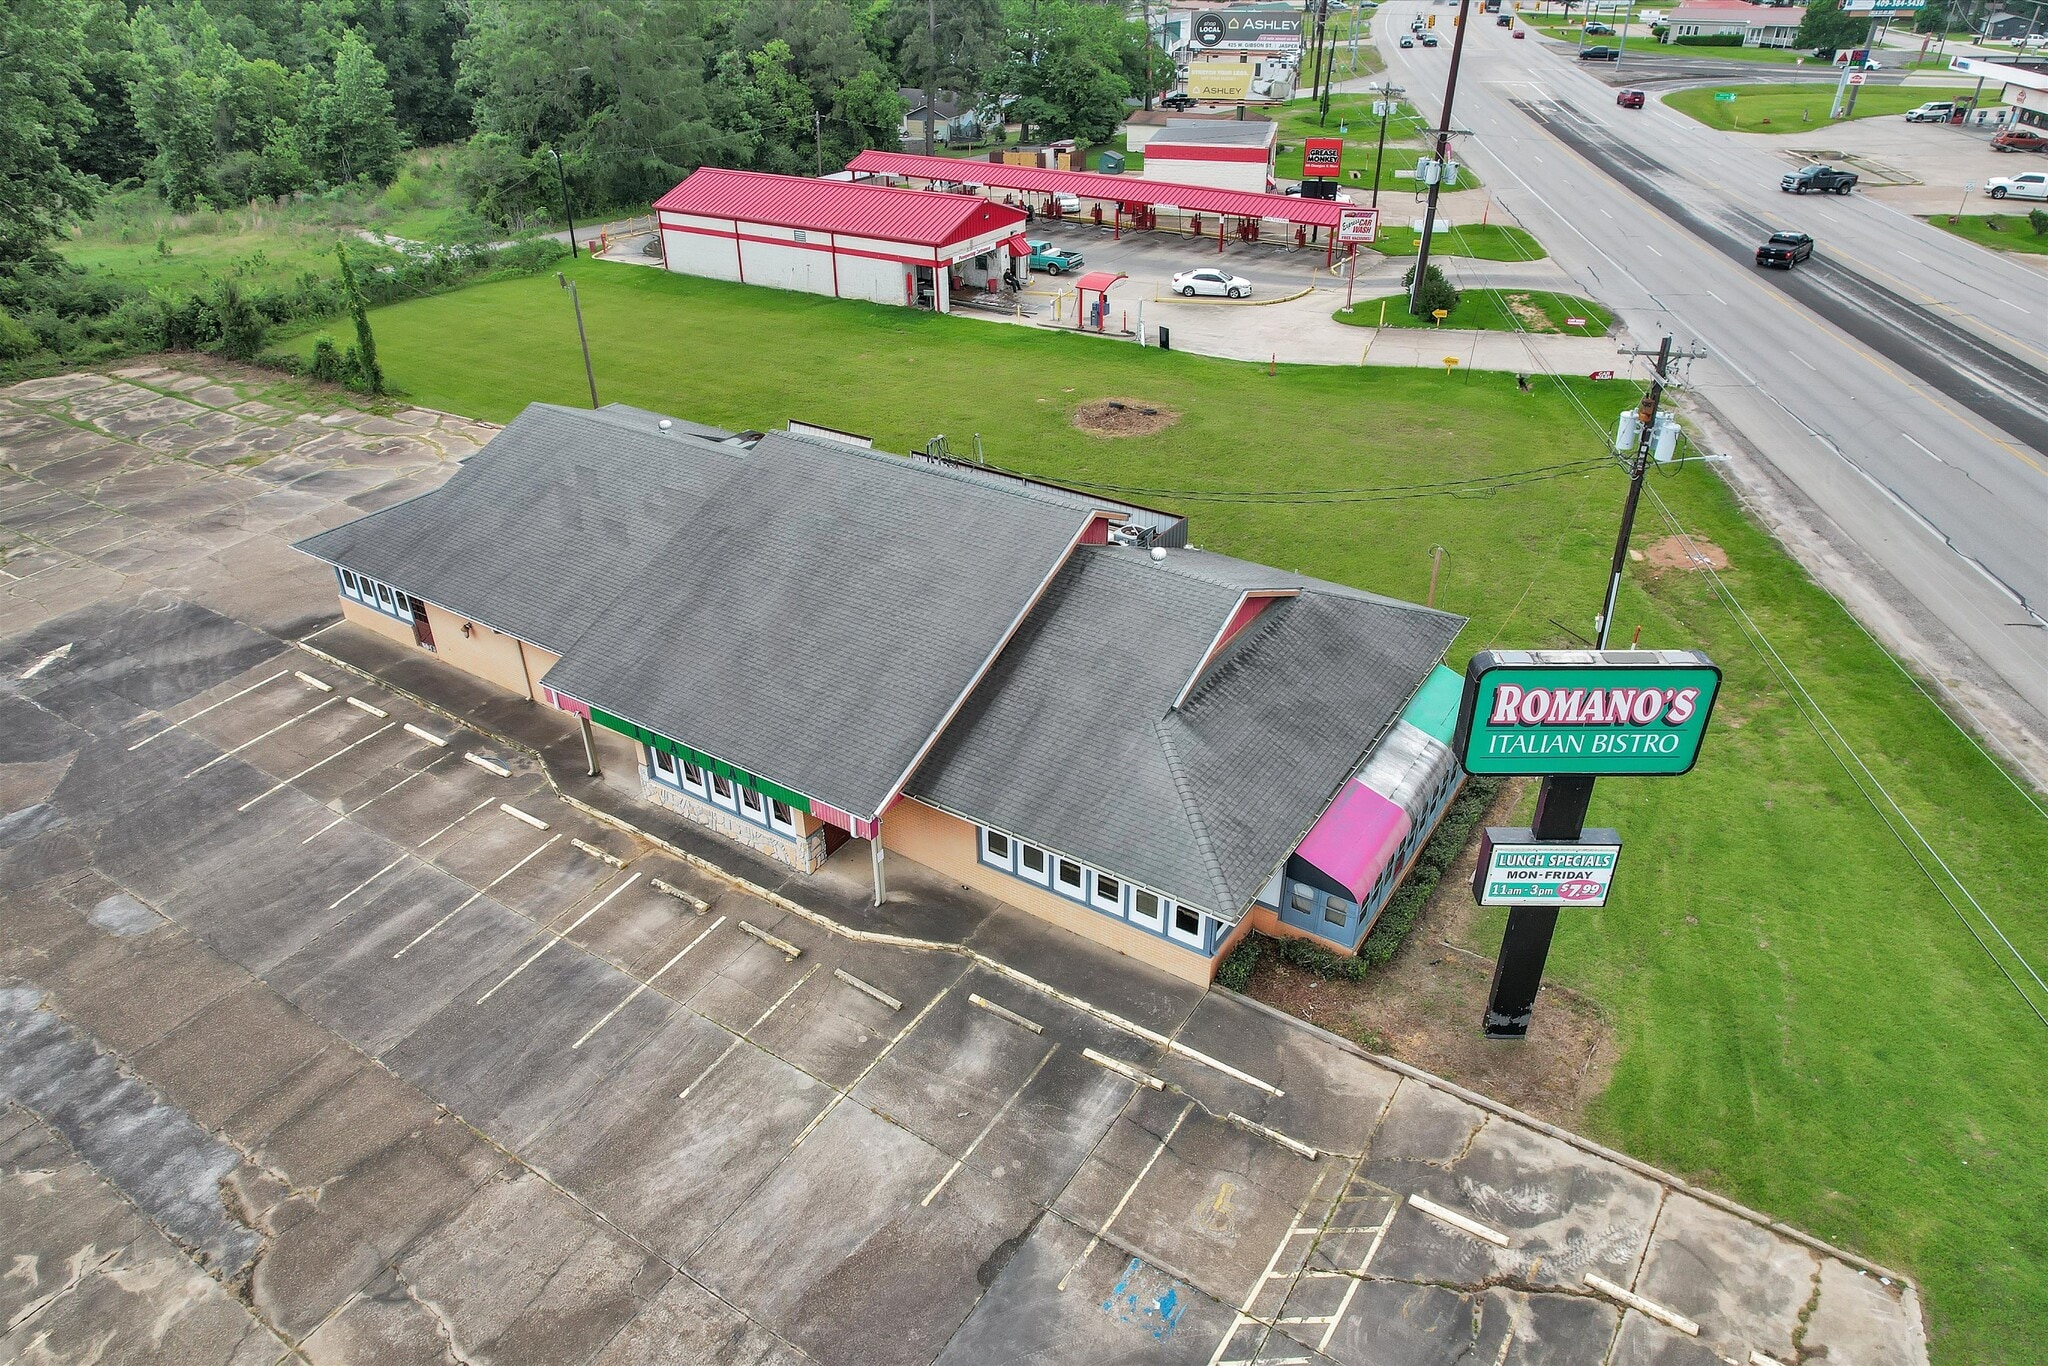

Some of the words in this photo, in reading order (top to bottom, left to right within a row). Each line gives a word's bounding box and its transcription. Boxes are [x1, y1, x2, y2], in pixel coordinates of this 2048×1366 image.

[1243, 18, 1300, 31] ASHLEY
[1203, 86, 1242, 95] ASHLEY
[1310, 149, 1338, 157] GREASE
[1359, 219, 1373, 227] CAR
[1352, 226, 1372, 234] WASH
[1489, 684, 1700, 726] ROMANO'S
[1489, 734, 1585, 754] ITALIAN
[1591, 734, 1680, 754] BISTRO
[1499, 854, 1545, 866] LUNCH
[1548, 855, 1611, 867] SPECIALS
[1491, 884, 1522, 896] 11am
[1529, 884, 1554, 897] 3pm
[1560, 883, 1600, 897] $7.99
